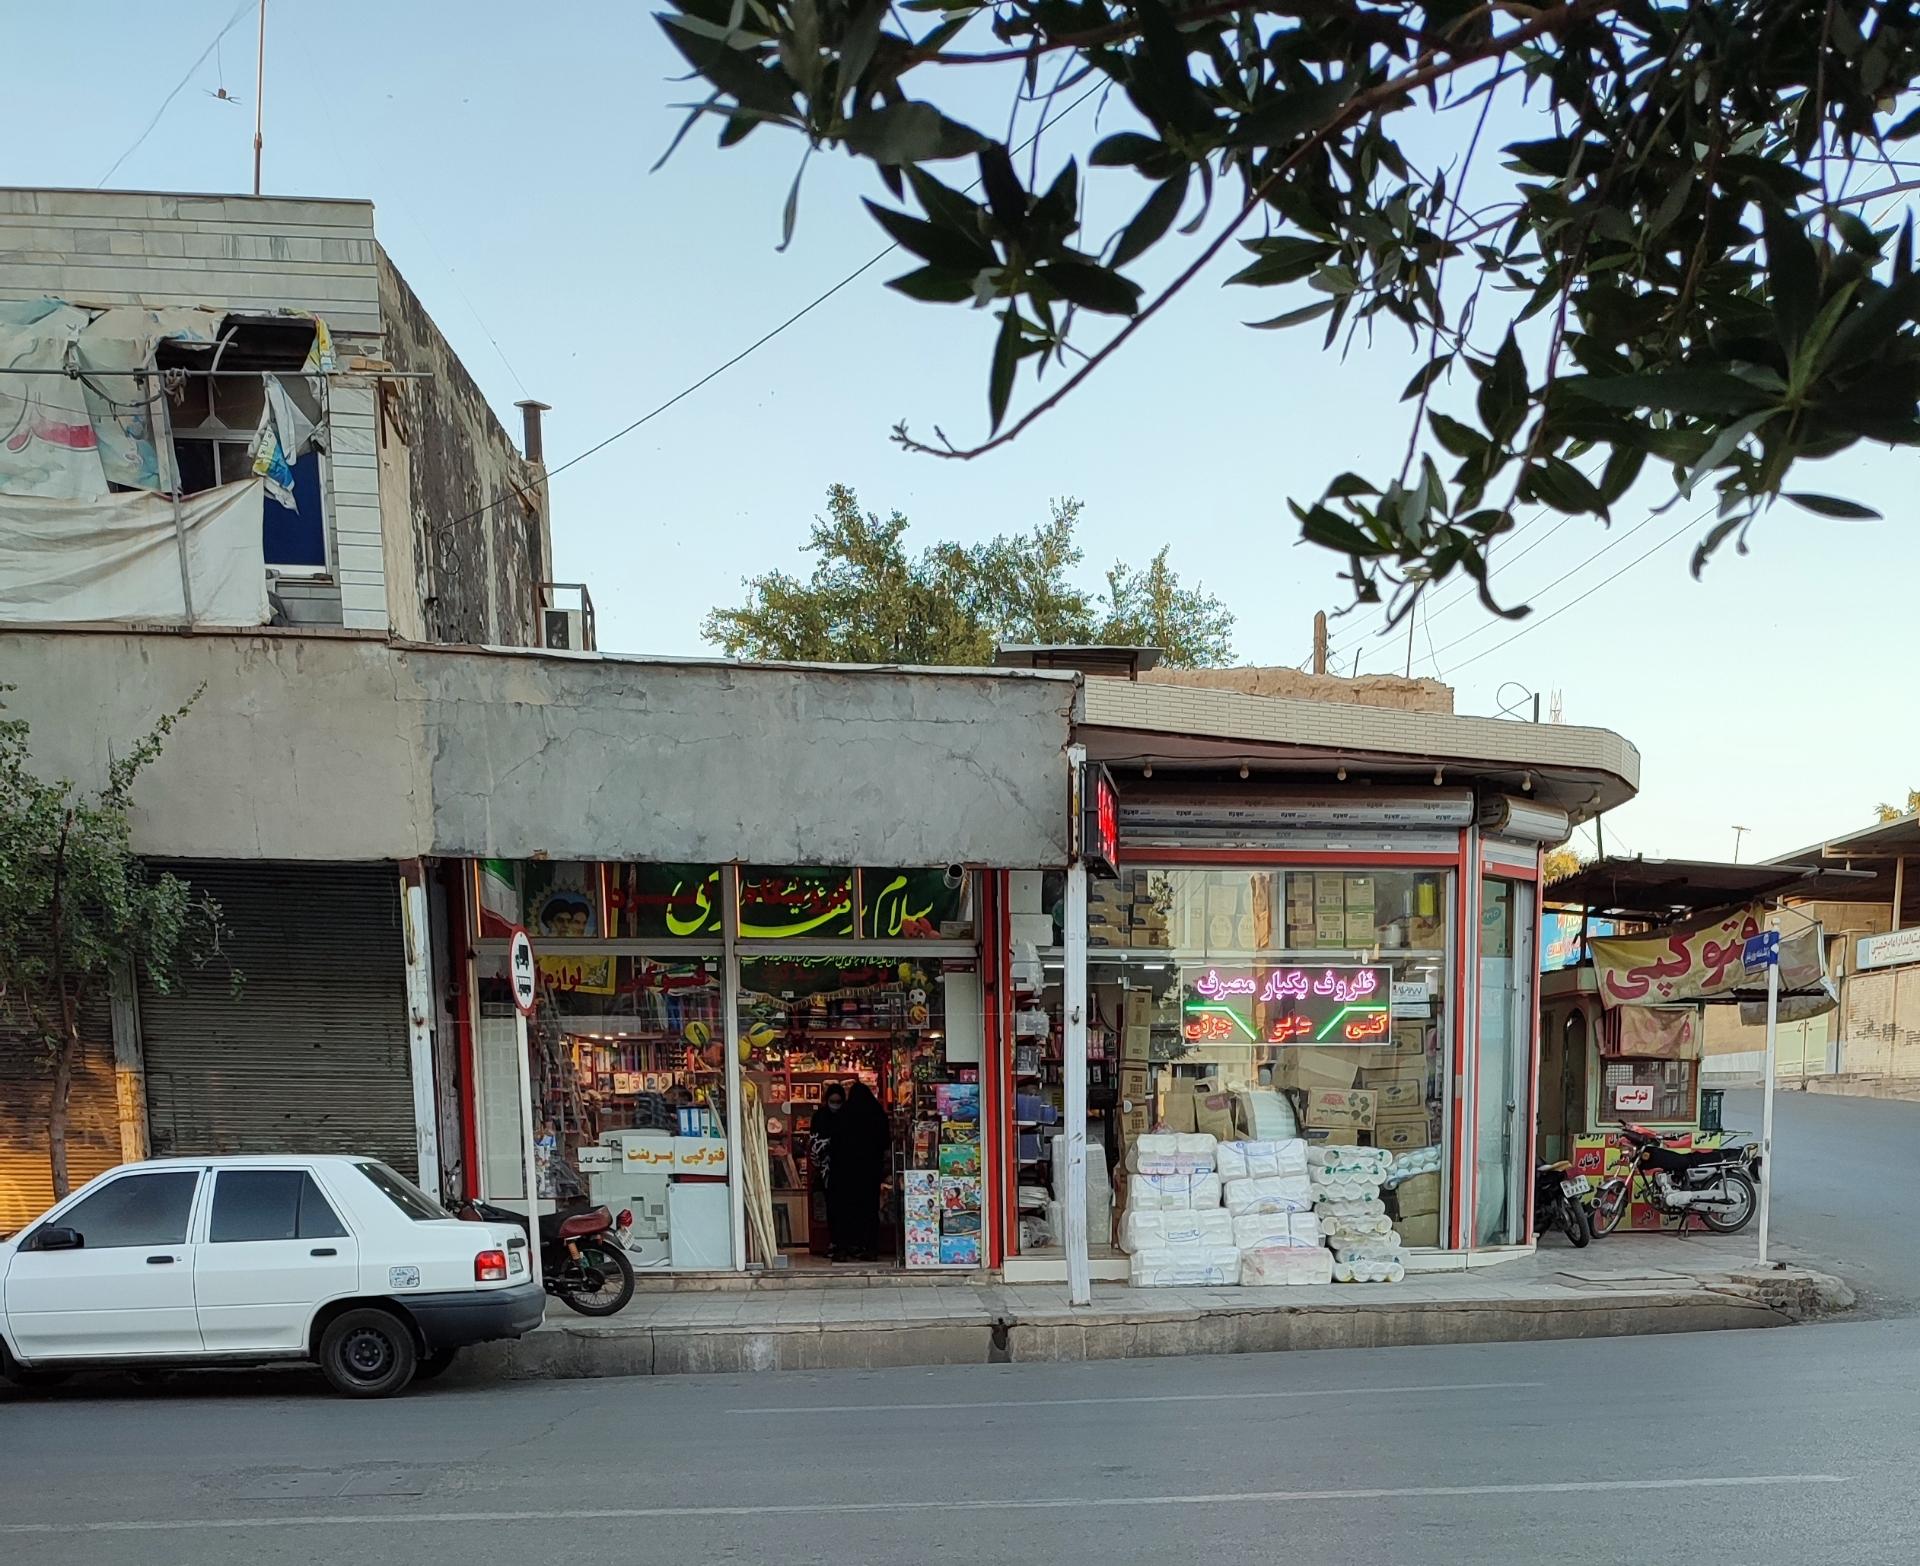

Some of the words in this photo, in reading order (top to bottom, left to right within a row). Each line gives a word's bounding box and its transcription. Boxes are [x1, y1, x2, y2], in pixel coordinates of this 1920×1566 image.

[873, 875, 934, 938] سلام
[1197, 970, 1257, 1001] مصرف
[1260, 971, 1309, 1001] یکبار
[1314, 970, 1377, 1001] ظروف
[1619, 1089, 1648, 1104] فتوکپی
[627, 1147, 674, 1165] پرینت
[681, 1146, 726, 1165] فتوکپی
